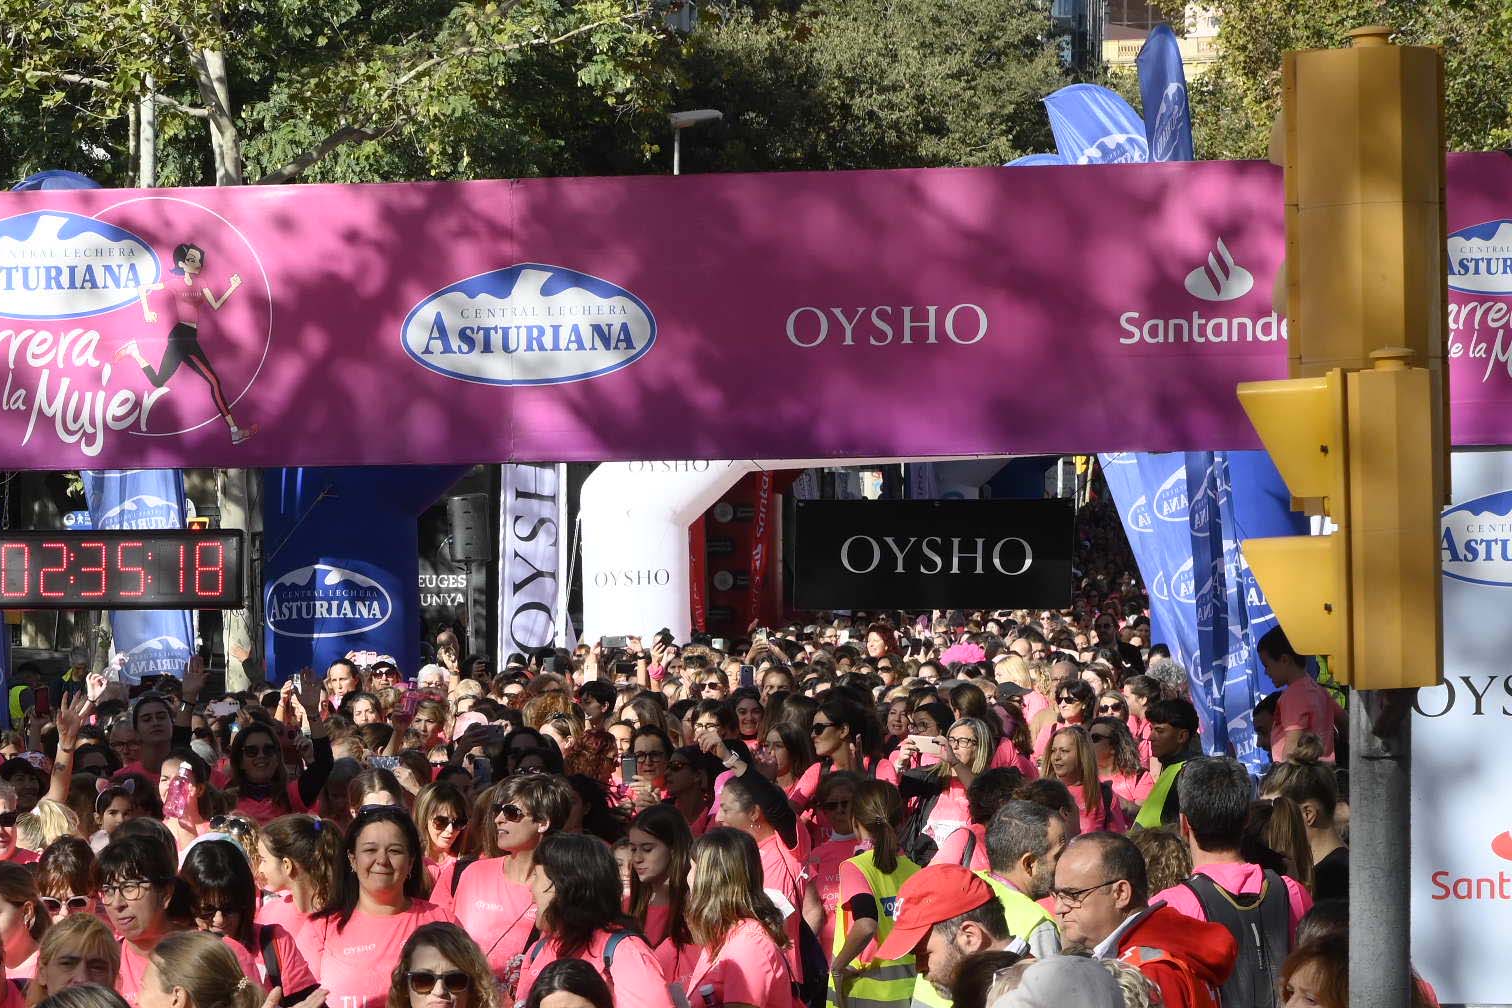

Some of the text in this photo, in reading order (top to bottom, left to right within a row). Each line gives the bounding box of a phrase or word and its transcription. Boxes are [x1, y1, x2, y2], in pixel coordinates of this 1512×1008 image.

[63, 245, 136, 258] LECHERA
[460, 304, 628, 318] CENTRAL LECHERA
[421, 311, 636, 355] ASTURIANA
[786, 304, 988, 347] OYSHO
[1470, 331, 1487, 358] la
[2, 370, 26, 411] la
[21, 362, 171, 457] Mujer
[840, 534, 1034, 576] OYSHO
[0, 541, 224, 597] 02:35:18
[419, 575, 467, 588] EUGES
[594, 568, 670, 587] OYSHO
[270, 595, 383, 622] ASTURIANA
[420, 593, 464, 606] UNYA
